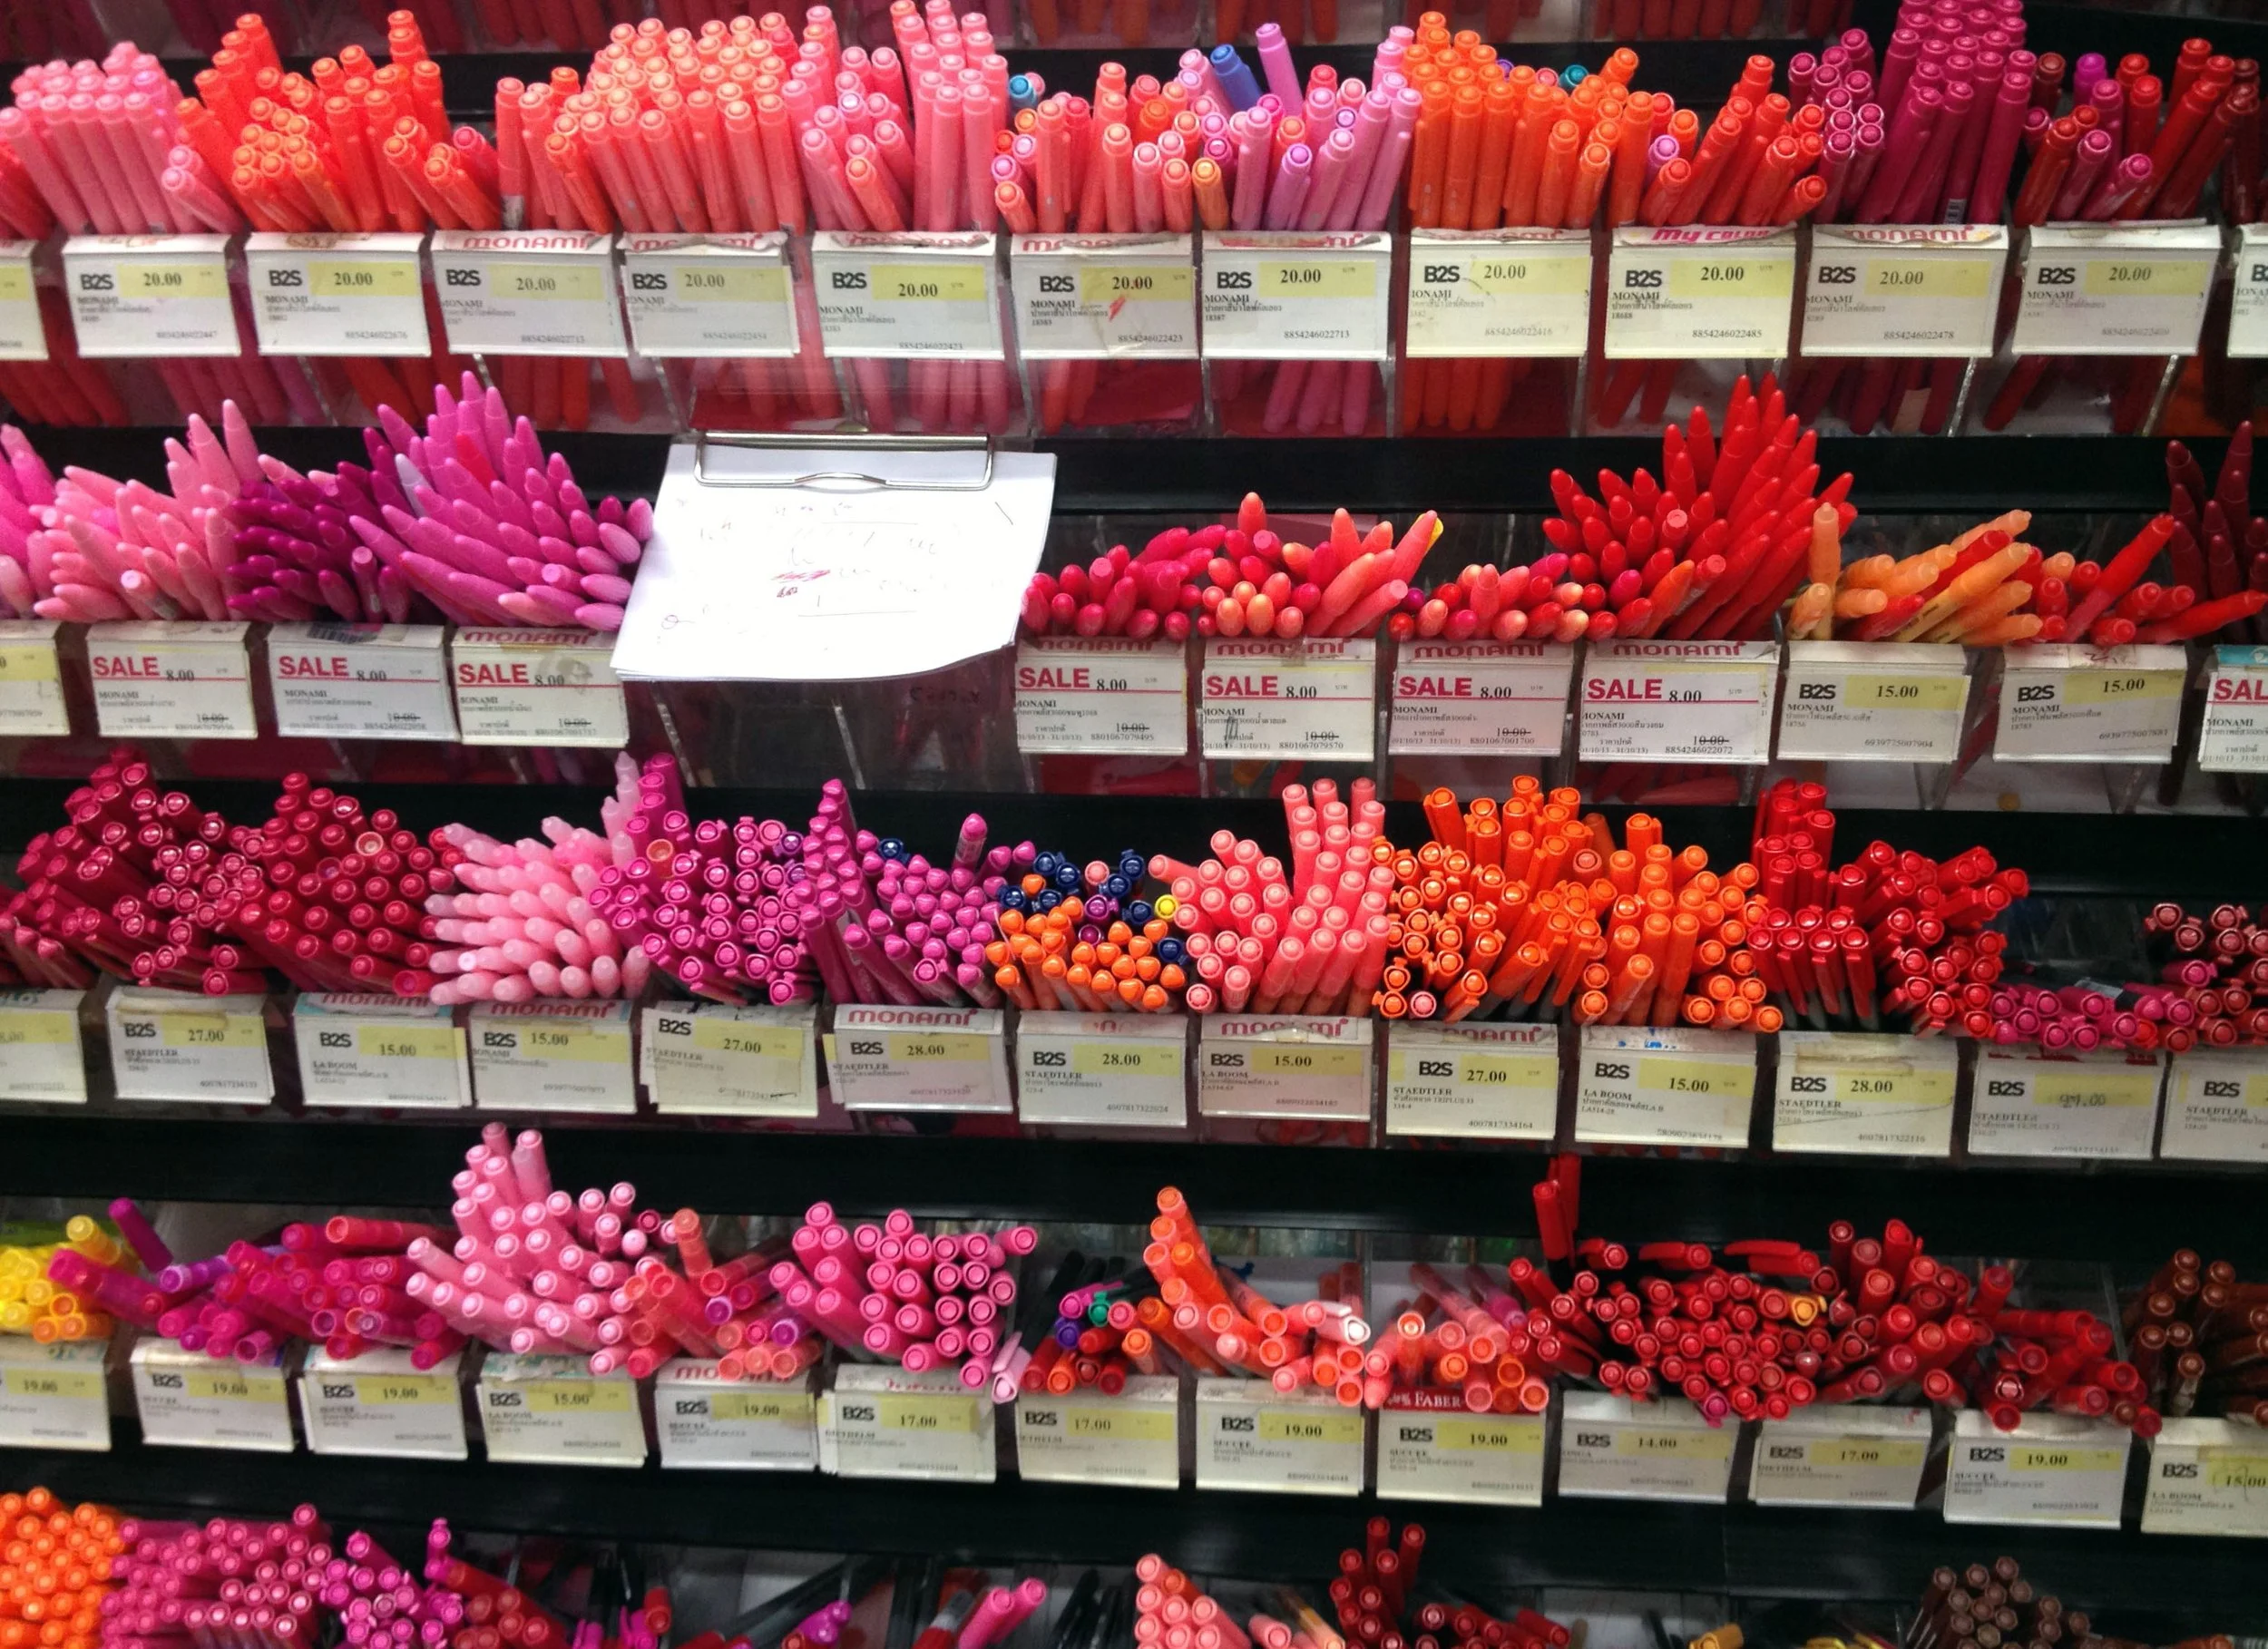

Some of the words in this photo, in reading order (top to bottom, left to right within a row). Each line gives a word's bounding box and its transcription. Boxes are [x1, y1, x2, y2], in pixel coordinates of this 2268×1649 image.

[269, 270, 302, 287] B2S
[335, 272, 373, 286] 20.00
[446, 268, 481, 286] B2S
[1281, 269, 1321, 283] 20.00
[1423, 266, 1460, 282] B2S
[1484, 265, 1526, 279] 20.00
[1626, 270, 1662, 288] B2S
[1701, 267, 1744, 281] 20.00
[1818, 267, 1856, 284] B2S
[1880, 271, 1923, 286] 20.00
[2038, 268, 2075, 285] B2S
[2108, 267, 2151, 281] 20.00
[81, 274, 113, 289] B2S
[143, 273, 182, 287] 20.00
[517, 278, 556, 291] 20.00
[632, 273, 668, 289] B2S
[686, 274, 725, 288] 20.00
[833, 272, 866, 288] B2S
[1040, 276, 1075, 292] B2S
[1112, 276, 1153, 290] 20.00
[1217, 271, 1251, 288] B2S
[898, 283, 938, 298] 20.00
[1612, 292, 1659, 301] MONAMI
[1031, 300, 1076, 308] MONAMI
[1205, 295, 1249, 303] MONAMI
[1284, 330, 1350, 339] 8854246022713
[1692, 329, 1762, 337] 8854246022485
[1414, 640, 1550, 658] monami
[1613, 640, 1746, 656] monami
[93, 656, 161, 677] SALE
[166, 669, 195, 682] 8.00
[278, 657, 349, 677] SALE
[357, 670, 386, 682] 8.00
[459, 664, 529, 684] SALE
[535, 675, 564, 687] 8.00
[1019, 668, 1090, 688] SALE
[1097, 678, 1127, 691] 8.00
[2103, 678, 2146, 693] 15.00
[1206, 676, 1278, 696] SALE
[1286, 686, 1316, 698] 8.00
[1399, 677, 1472, 697] SALE
[1481, 687, 1512, 699] 8.00
[1588, 678, 1662, 699] SALE
[1668, 690, 1702, 703] 8.00
[1799, 684, 1836, 700] B2S
[1876, 686, 1919, 698] 15.00
[2018, 685, 2055, 702] B2S
[1393, 706, 1438, 714] MONAMI
[1787, 704, 1833, 712] MONAMI
[2012, 704, 2059, 715] MONAMI
[1665, 746, 1733, 755] 8854246022072
[491, 1000, 615, 1018] monami
[848, 1009, 978, 1026] monami
[124, 1023, 157, 1038] B2S
[659, 1018, 691, 1036] B2S
[189, 1029, 225, 1042] 27.00
[320, 1032, 352, 1048] B2S
[484, 1032, 516, 1048] B2S
[531, 1032, 569, 1046] 15.00
[379, 1044, 416, 1057] 15.00
[723, 1038, 762, 1053] 27.00
[850, 1041, 884, 1055] B2S
[907, 1044, 945, 1057] 28.00
[1033, 1051, 1066, 1067] B2S
[1102, 1053, 1141, 1066] 28.00
[1211, 1054, 1244, 1067] B2S
[1274, 1055, 1312, 1068] 15.00
[1025, 1071, 1082, 1079] STAEDTLER
[1419, 1061, 1453, 1077] B2S
[1466, 1069, 1507, 1083] 27.00
[1595, 1062, 1630, 1079] B2S
[1668, 1077, 1709, 1092] 15.00
[1791, 1076, 1826, 1092] B2S
[1850, 1080, 1893, 1094] 28.00
[1988, 1080, 2025, 1097] B2S
[2204, 1081, 2241, 1098] B2S
[1393, 1087, 1452, 1096] STAEDTLER
[1599, 1090, 1632, 1101] BOOM
[1778, 1099, 1842, 1108] STAEDTLER
[152, 1373, 182, 1389] B2S
[212, 1381, 248, 1395] 19.00
[323, 1385, 355, 1400] B2S
[382, 1389, 418, 1400] 19.00
[489, 1392, 522, 1407] B2S
[553, 1393, 590, 1405] 15.00
[676, 1400, 708, 1415] B2S
[744, 1405, 780, 1417] 19.00
[843, 1406, 875, 1421] B2S
[900, 1415, 937, 1428] 17.00
[1025, 1411, 1058, 1427] B2S
[1074, 1419, 1111, 1430] 17.00
[1221, 1417, 1255, 1431] B2S
[1286, 1424, 1323, 1437] 19.00
[1400, 1428, 1433, 1442] B2S
[1471, 1433, 1508, 1446] 19.00
[1577, 1433, 1611, 1448] B2S
[1638, 1436, 1677, 1449] 14.00
[1770, 1446, 1804, 1459] B2S
[1841, 1450, 1879, 1461] 17.00
[1970, 1447, 2005, 1462] B2S
[2028, 1454, 2068, 1467] 19.00
[2163, 1463, 2198, 1478] B2S
[2225, 1475, 2266, 1488] 15.00
